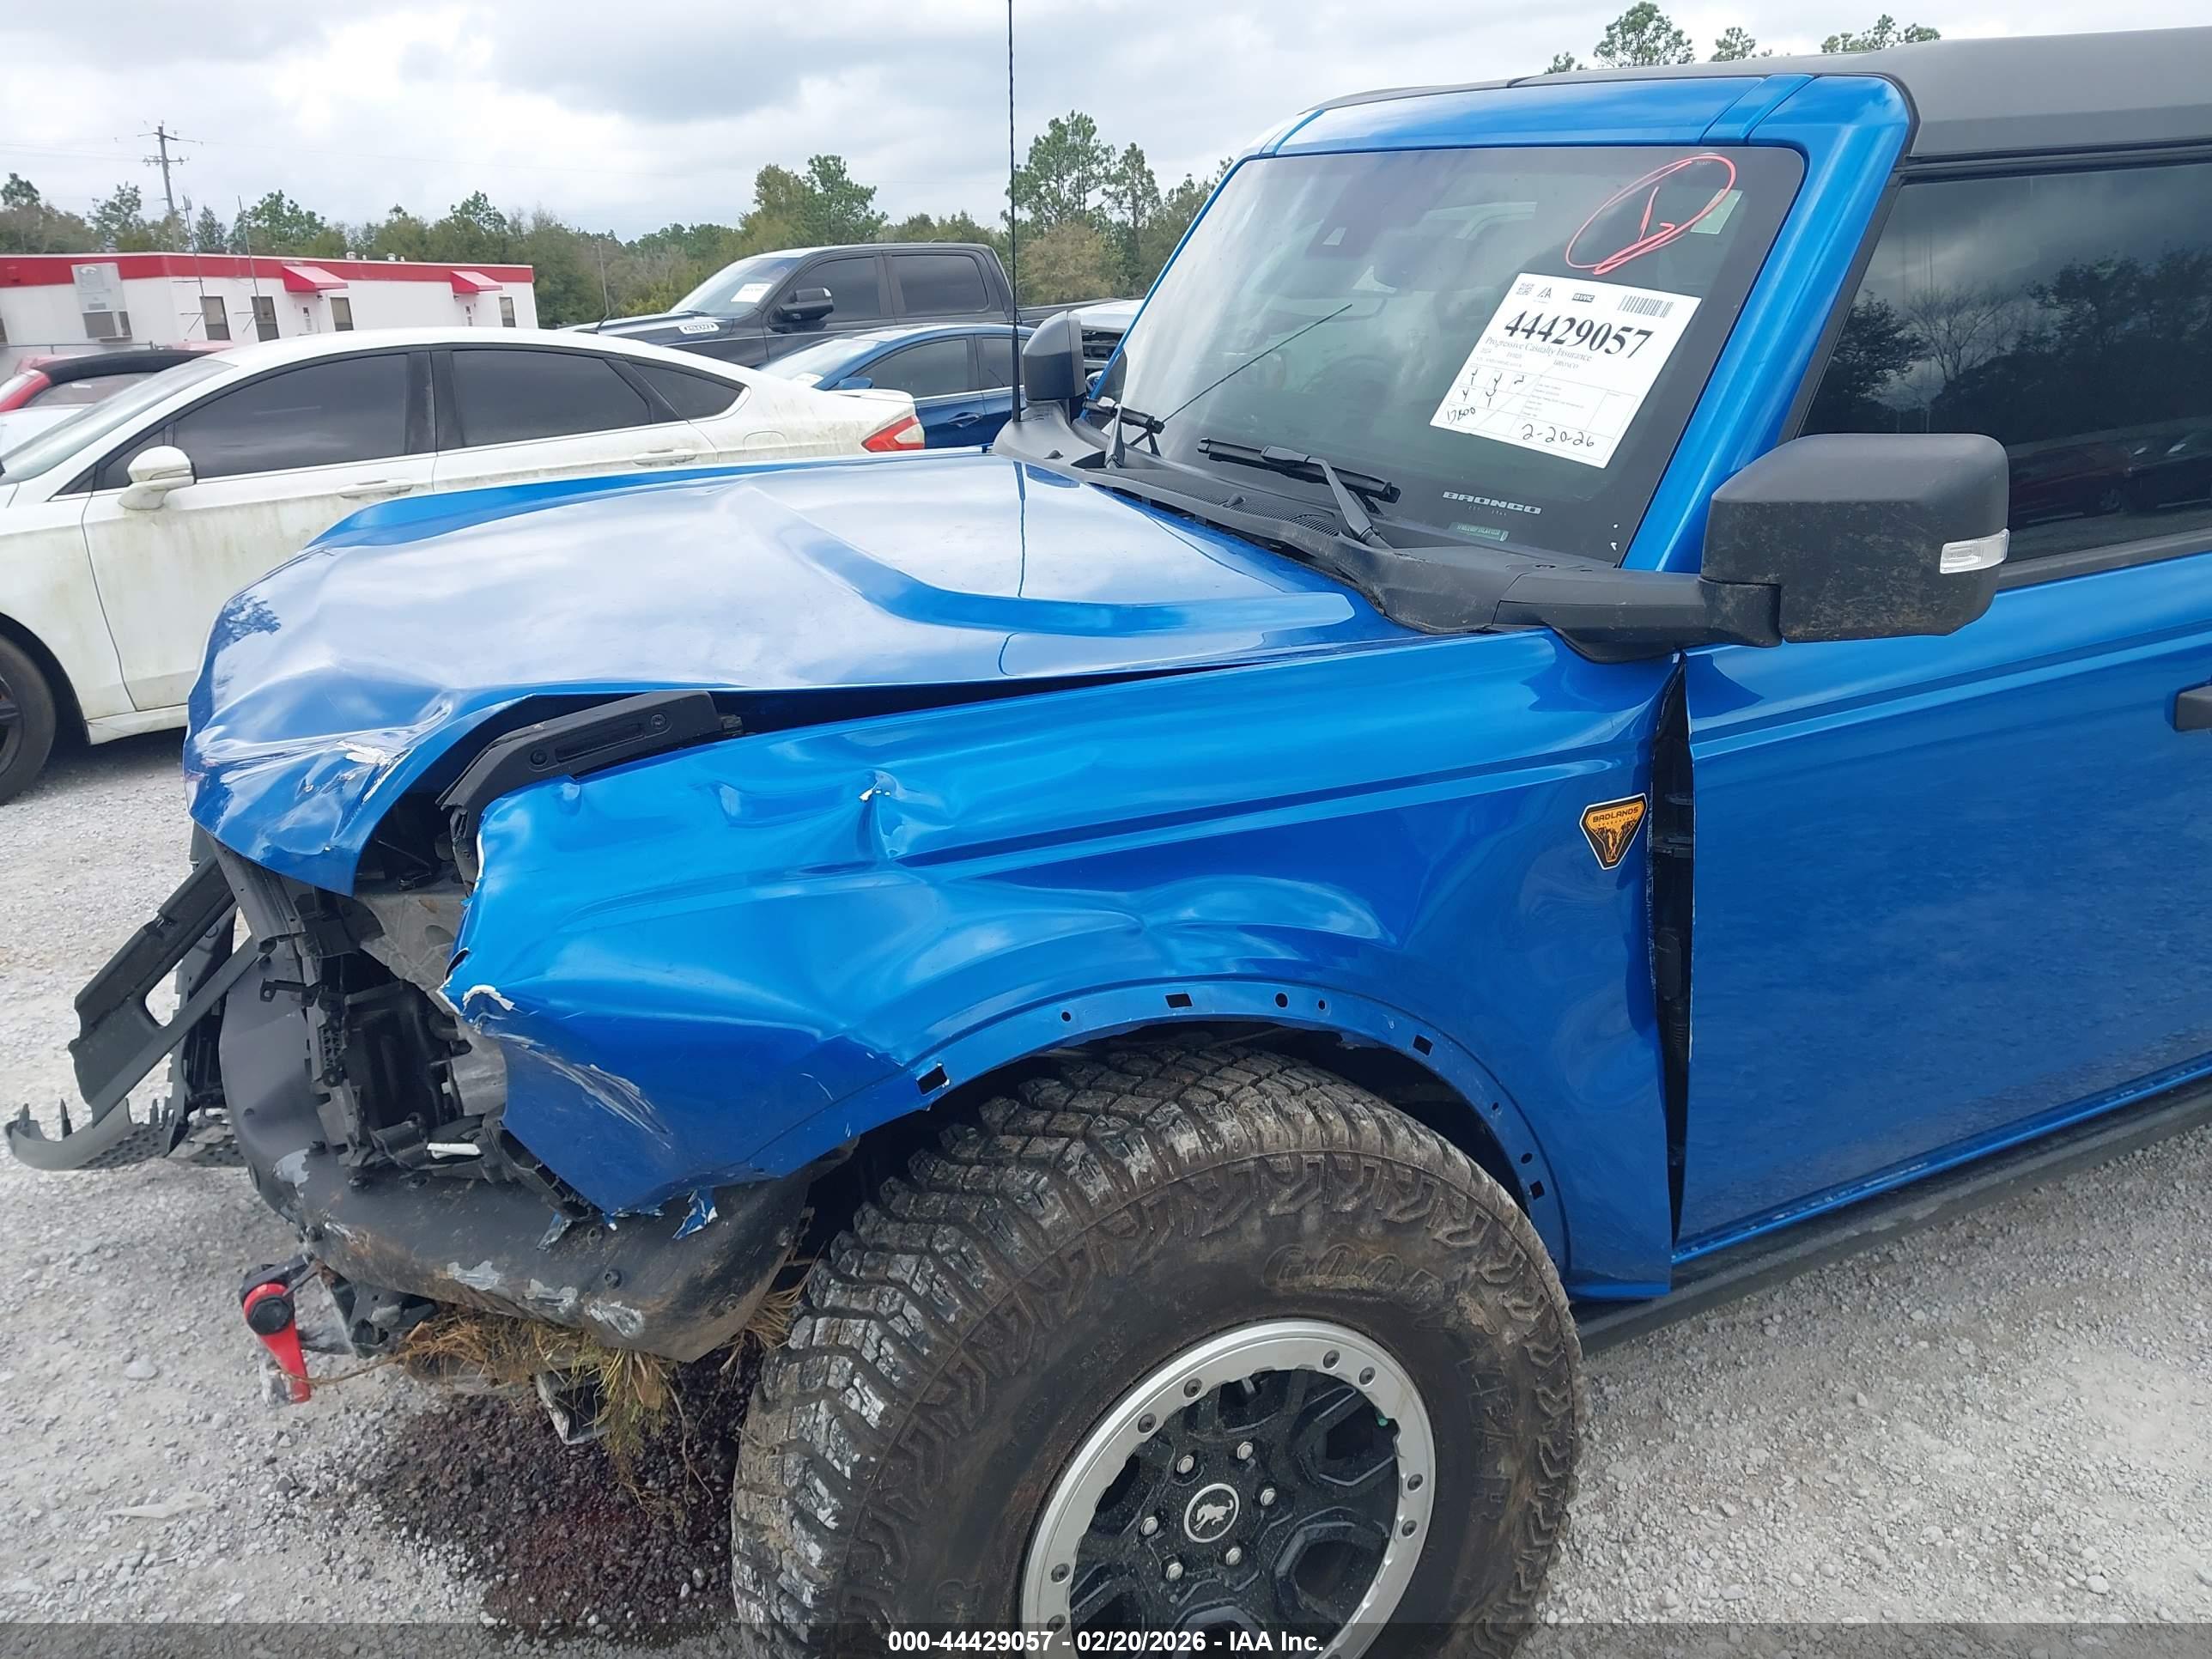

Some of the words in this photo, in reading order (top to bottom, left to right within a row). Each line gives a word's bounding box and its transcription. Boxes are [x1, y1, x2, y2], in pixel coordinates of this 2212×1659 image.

[1504, 310, 1654, 359] 44429057
[1443, 490, 1542, 515] BRONCO
[1592, 806, 1639, 823] BADLANDS
